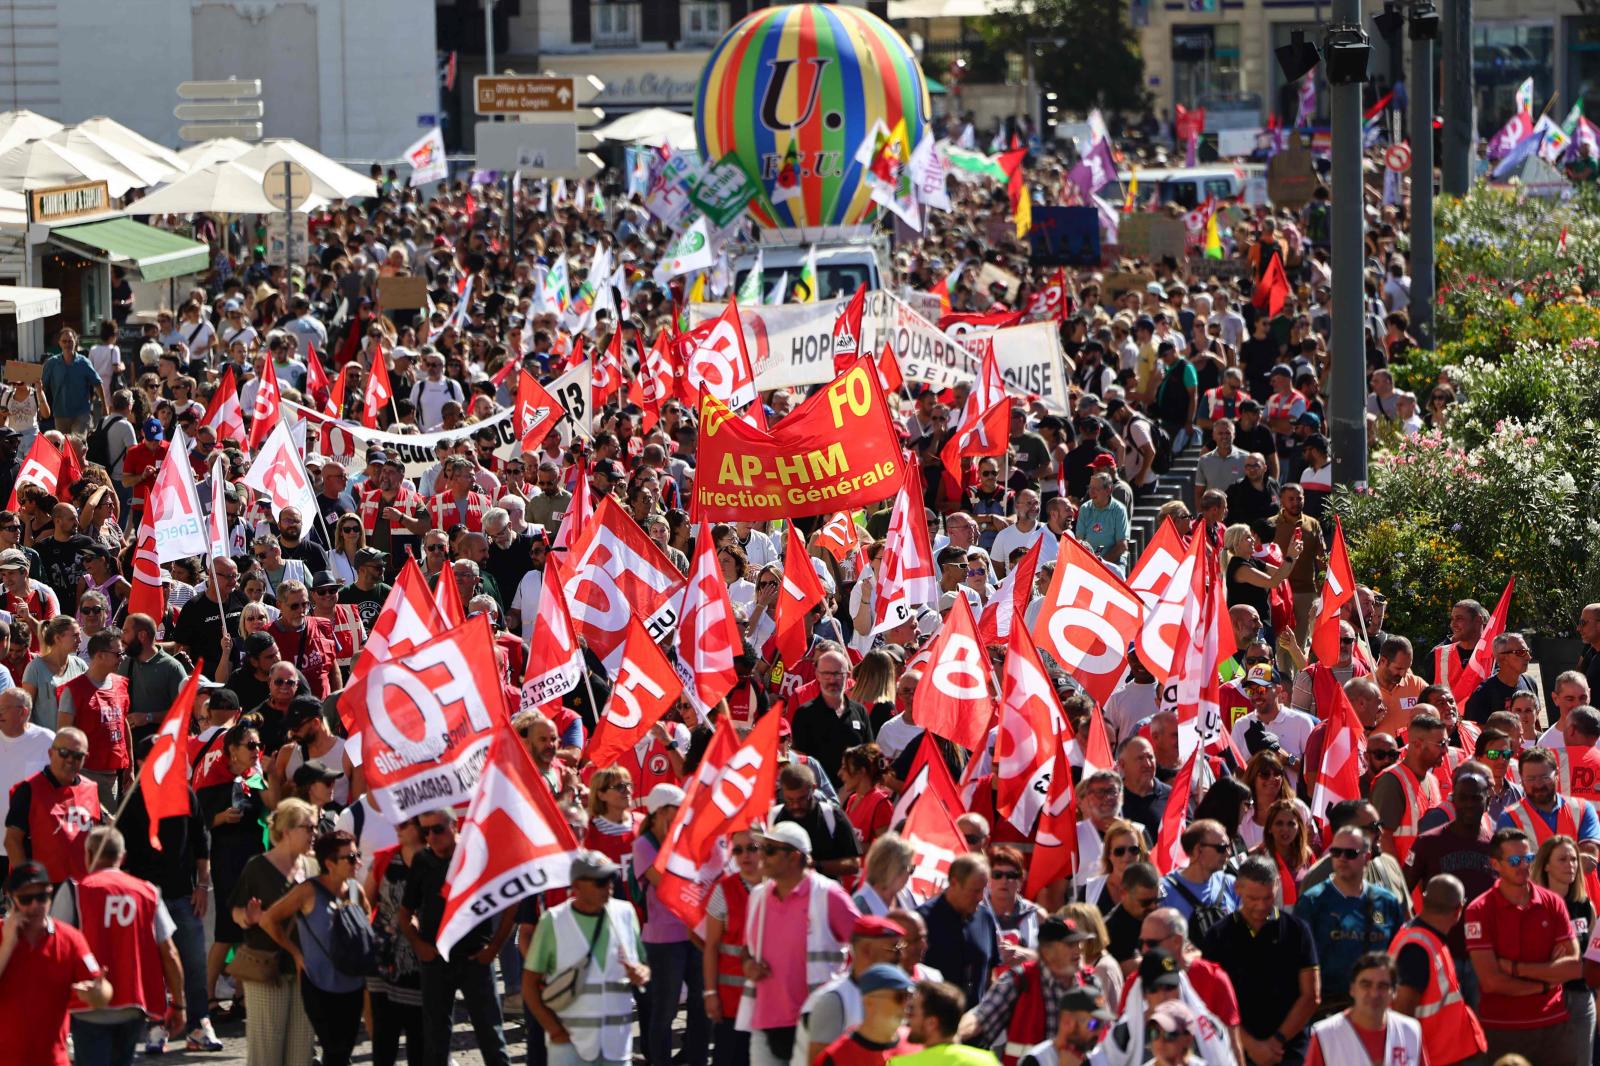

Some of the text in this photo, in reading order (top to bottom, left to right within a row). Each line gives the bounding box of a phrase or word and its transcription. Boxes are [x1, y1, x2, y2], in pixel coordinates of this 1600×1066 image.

[828, 366, 872, 429] FO
[717, 442, 850, 487] AP-HM
[787, 460, 896, 506] Générale
[779, 671, 803, 697] FO
[1407, 697, 1417, 707] FO
[1571, 767, 1595, 788] FO
[67, 805, 91, 832] FO
[103, 894, 138, 929] FO
[1466, 924, 1478, 935] FO
